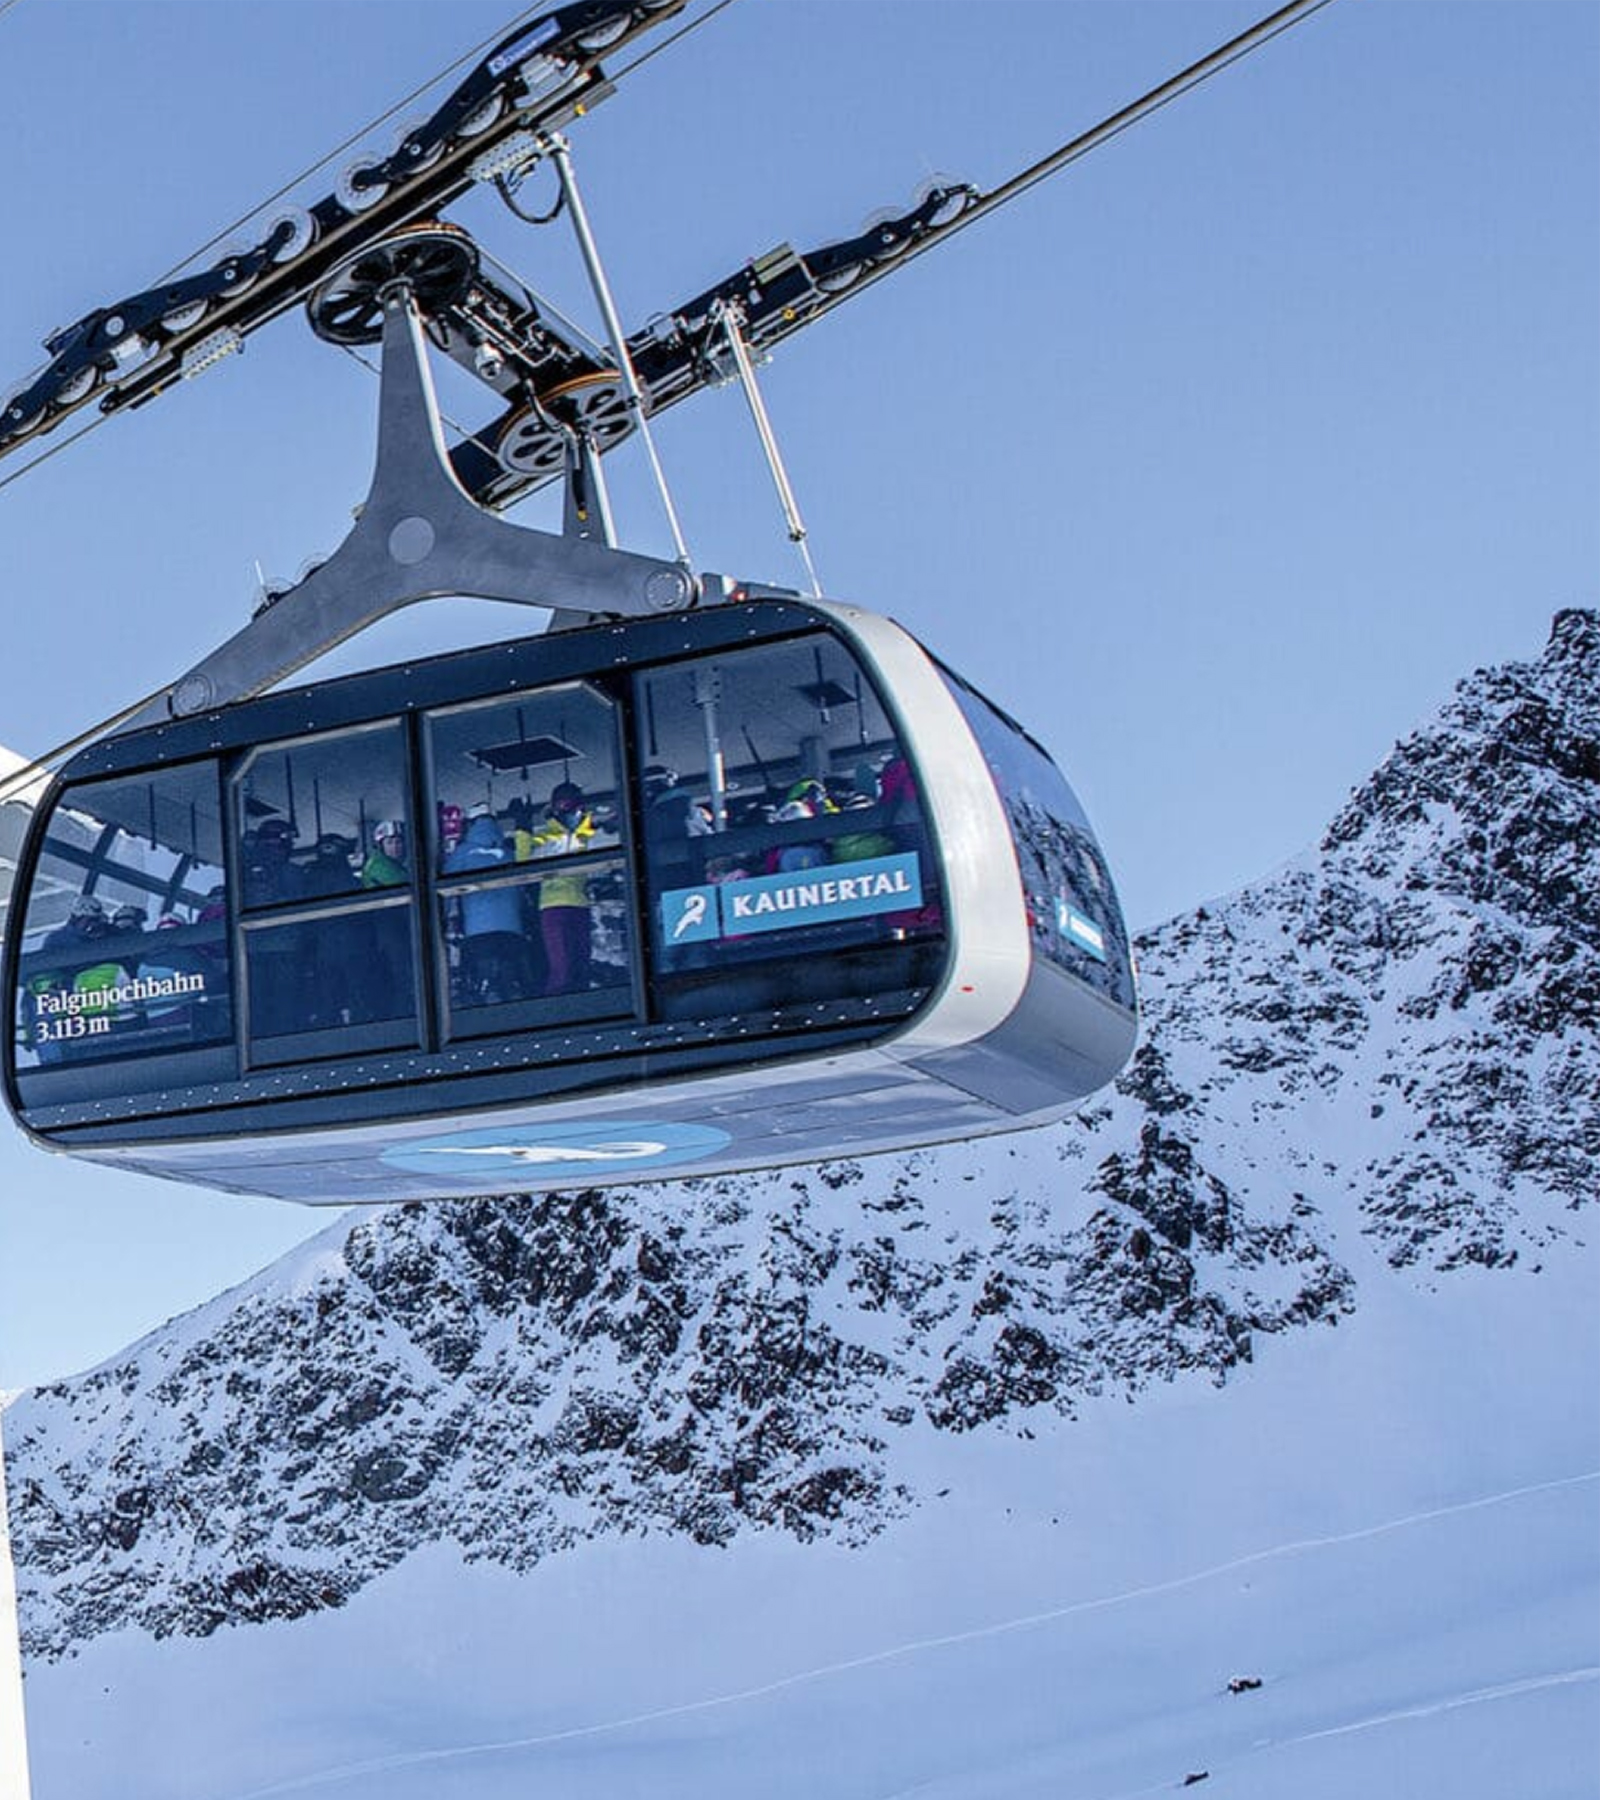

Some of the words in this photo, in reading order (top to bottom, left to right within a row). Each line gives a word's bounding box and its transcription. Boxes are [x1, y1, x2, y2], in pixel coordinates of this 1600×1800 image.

[733, 870, 911, 917] KAUNERTAL
[36, 971, 204, 1015] Falginjochbahn
[36, 1016, 87, 1043] 3.113
[88, 1016, 110, 1034] m
